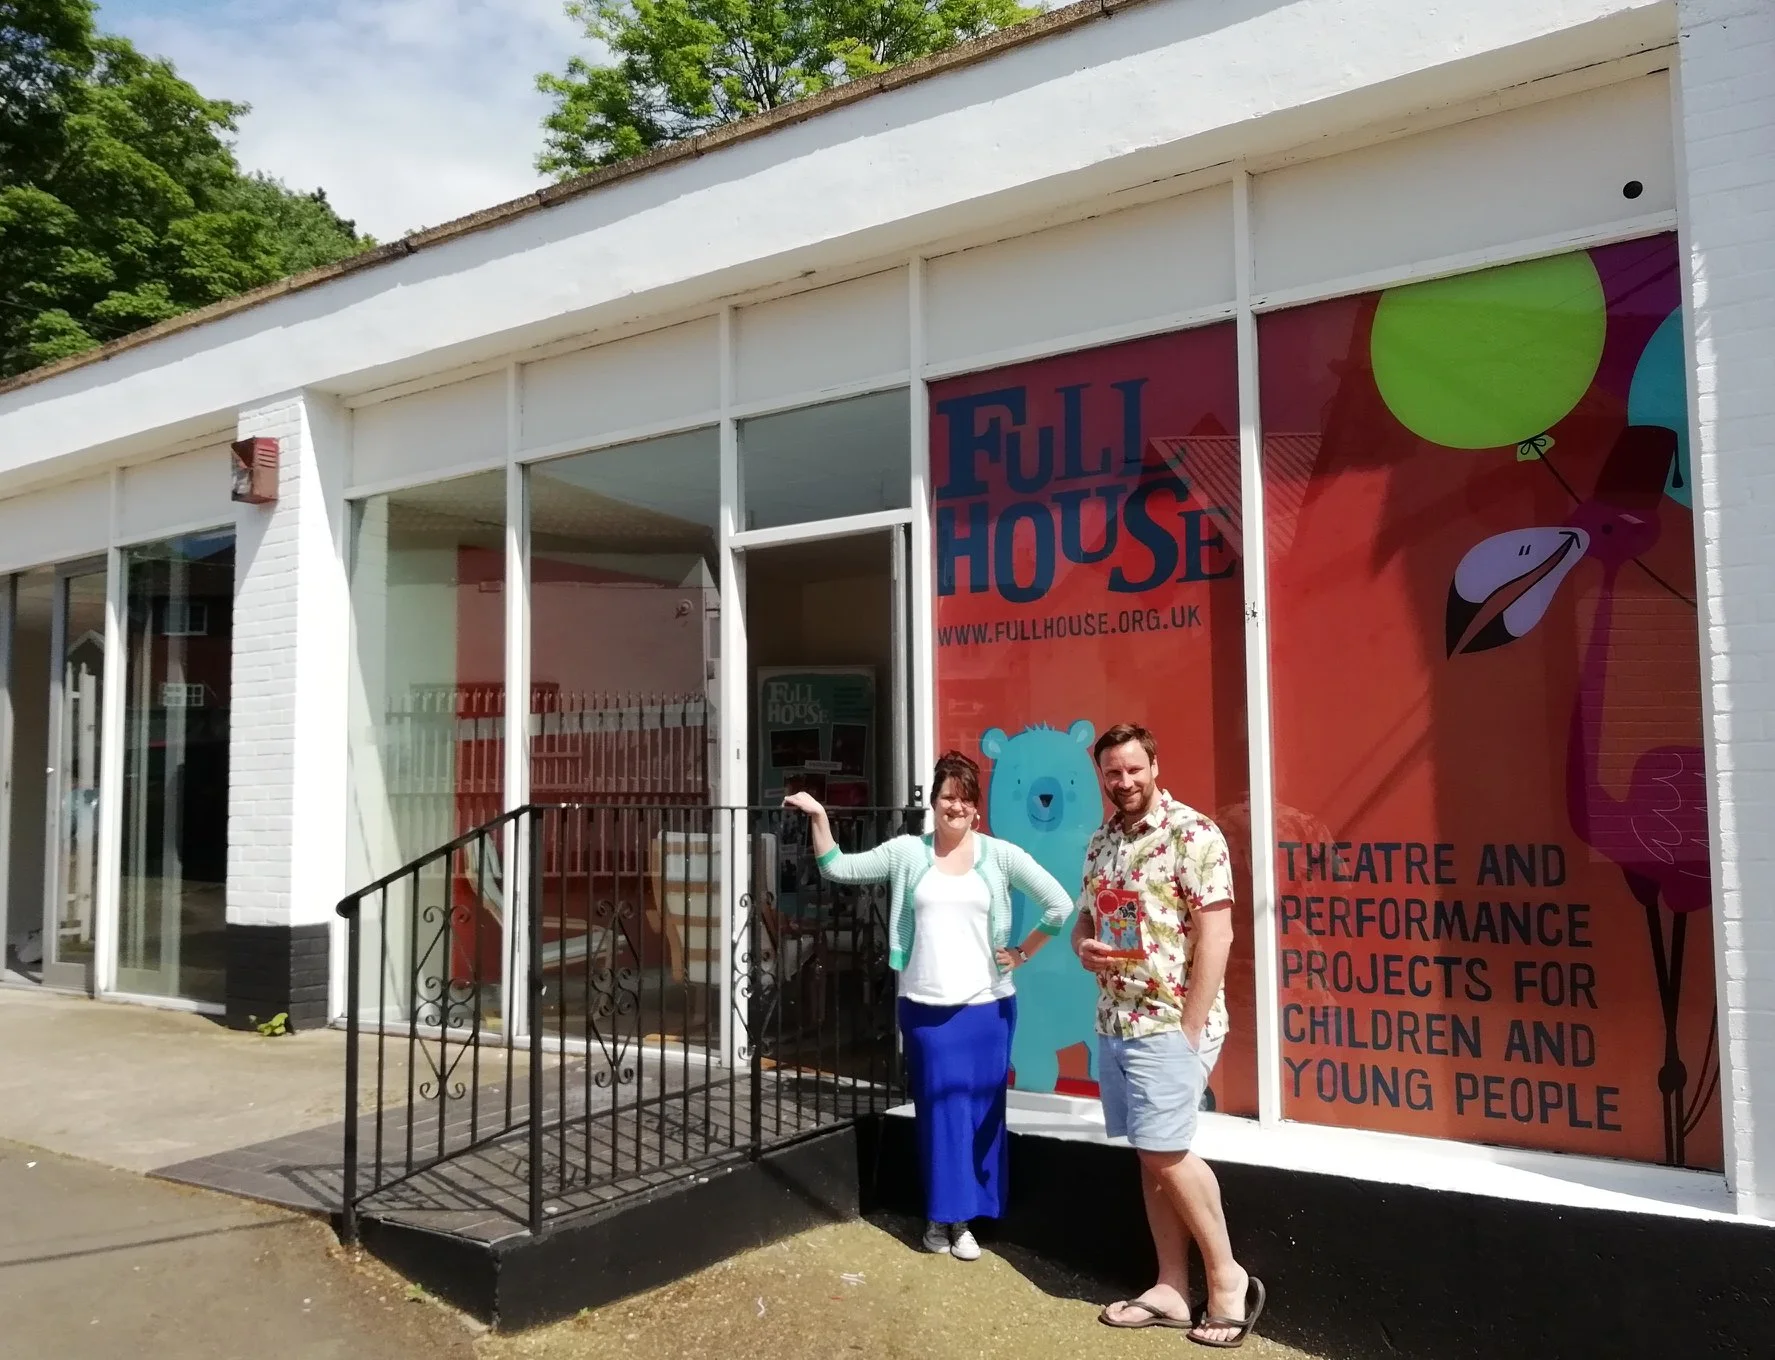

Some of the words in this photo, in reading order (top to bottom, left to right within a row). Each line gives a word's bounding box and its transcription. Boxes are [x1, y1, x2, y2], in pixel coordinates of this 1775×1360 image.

[936, 378, 1190, 497] FULL
[937, 477, 1237, 603] HOUSE
[938, 605, 1202, 646] WWW.FULLHOUSE.ORG.UK
[767, 700, 829, 724] HOUSE
[1279, 842, 1456, 885] THEATRE
[1477, 844, 1566, 887] AND
[1281, 895, 1593, 948] PERFORMANCE
[1282, 950, 1493, 1002] PROJECTS
[1514, 961, 1598, 1009] FOR
[1283, 1003, 1482, 1059] CHILDREN
[1504, 1019, 1596, 1068] AND
[1284, 1057, 1434, 1112] YOUNG
[1455, 1072, 1622, 1132] PEOPLE
